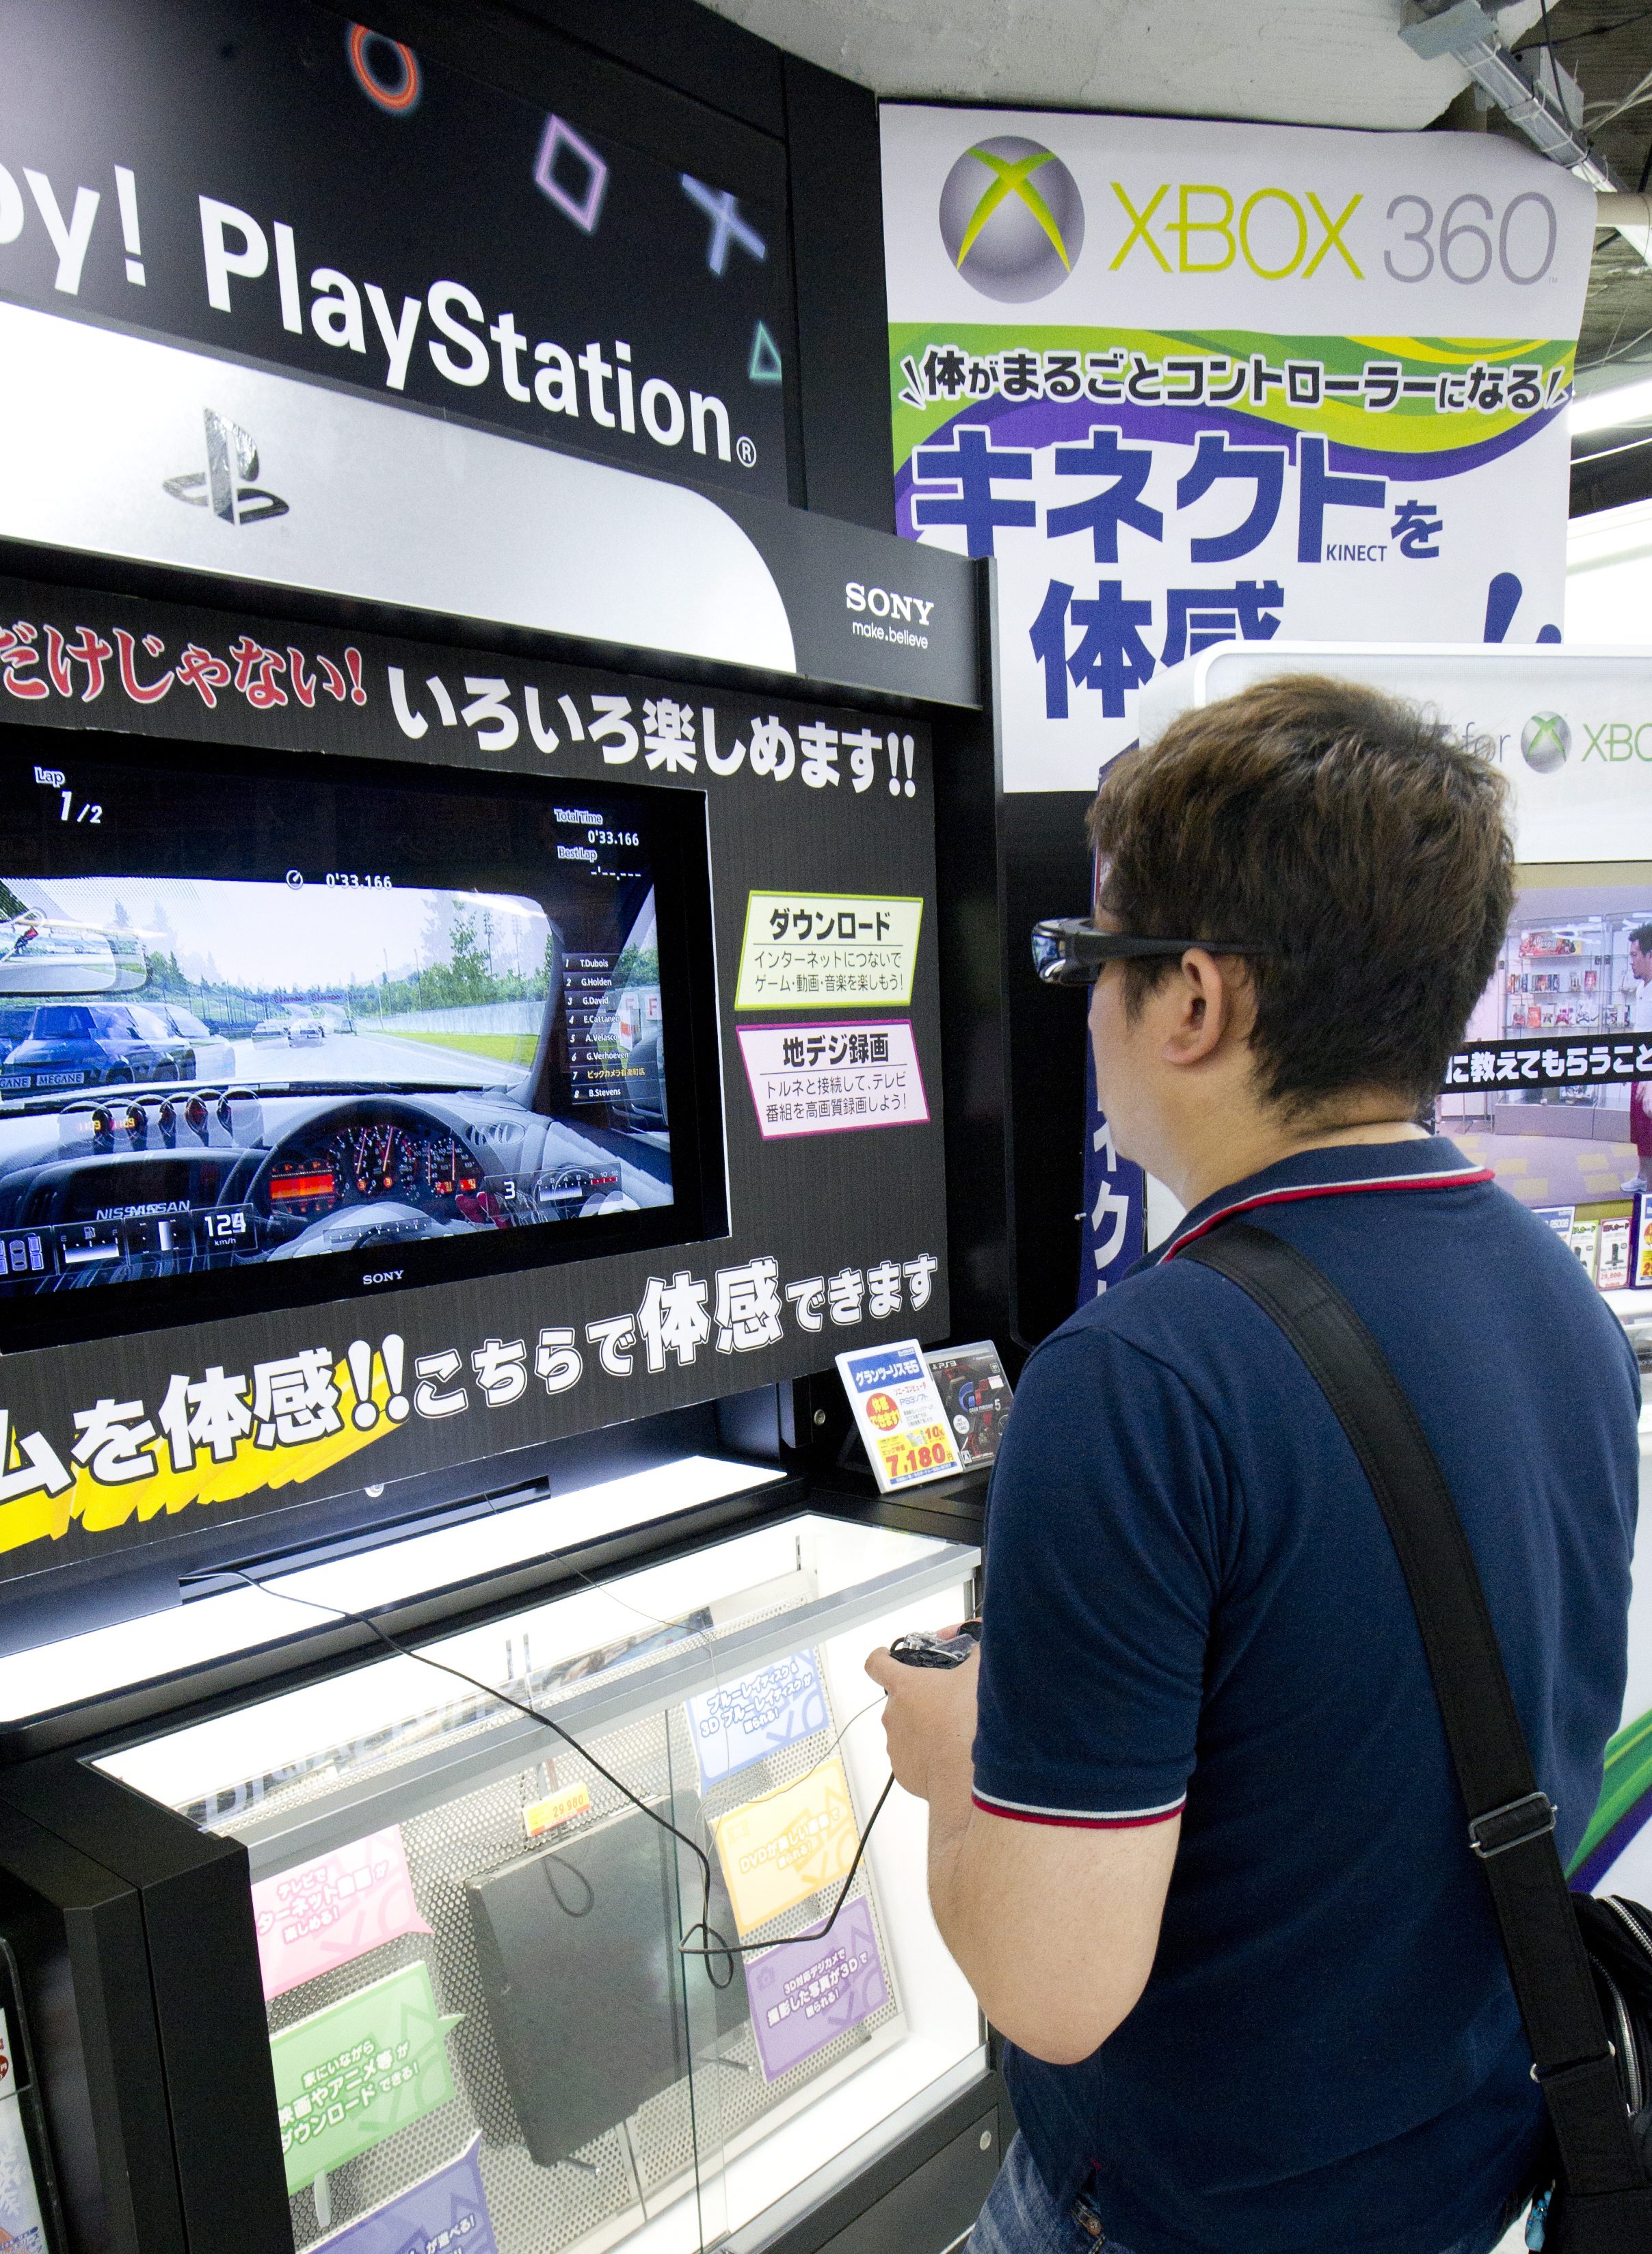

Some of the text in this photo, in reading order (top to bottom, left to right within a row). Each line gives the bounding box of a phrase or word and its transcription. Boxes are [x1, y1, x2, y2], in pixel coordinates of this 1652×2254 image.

[1108, 182, 1365, 281] XBOX
[1326, 544, 1387, 561] KINECT
[845, 582, 934, 626] SONY
[34, 766, 66, 787] Lap
[554, 808, 603, 825] Total Time
[587, 830, 639, 847] 0'33.166
[557, 845, 597, 863] Best Lap
[769, 908, 890, 941] ダウンロード
[580, 959, 609, 968] T.Dubois
[754, 951, 901, 969] インターネットにつないで
[566, 977, 612, 987] 2 G.Holden
[568, 996, 609, 1005] 3 G.David
[570, 1033, 617, 1043] 5 A.Velasco
[572, 1051, 629, 1061] 6 G.Verhoeven
[783, 1033, 889, 1067] 地デジ録画
[40, 1073, 82, 1084] MEGANE
[573, 1072, 578, 1080] 7
[767, 1070, 906, 1098] トルネと接続して、テレビ
[589, 1089, 621, 1098] B.Stevens
[766, 1093, 907, 1123] 番組を高画質録画しよう!
[503, 1180, 516, 1199] 3
[362, 1269, 404, 1285] SONY
[855, 1359, 920, 1387] グランツーリスモ5
[277, 1866, 328, 1900] テレビで
[302, 2039, 375, 2090] 家にいながら
